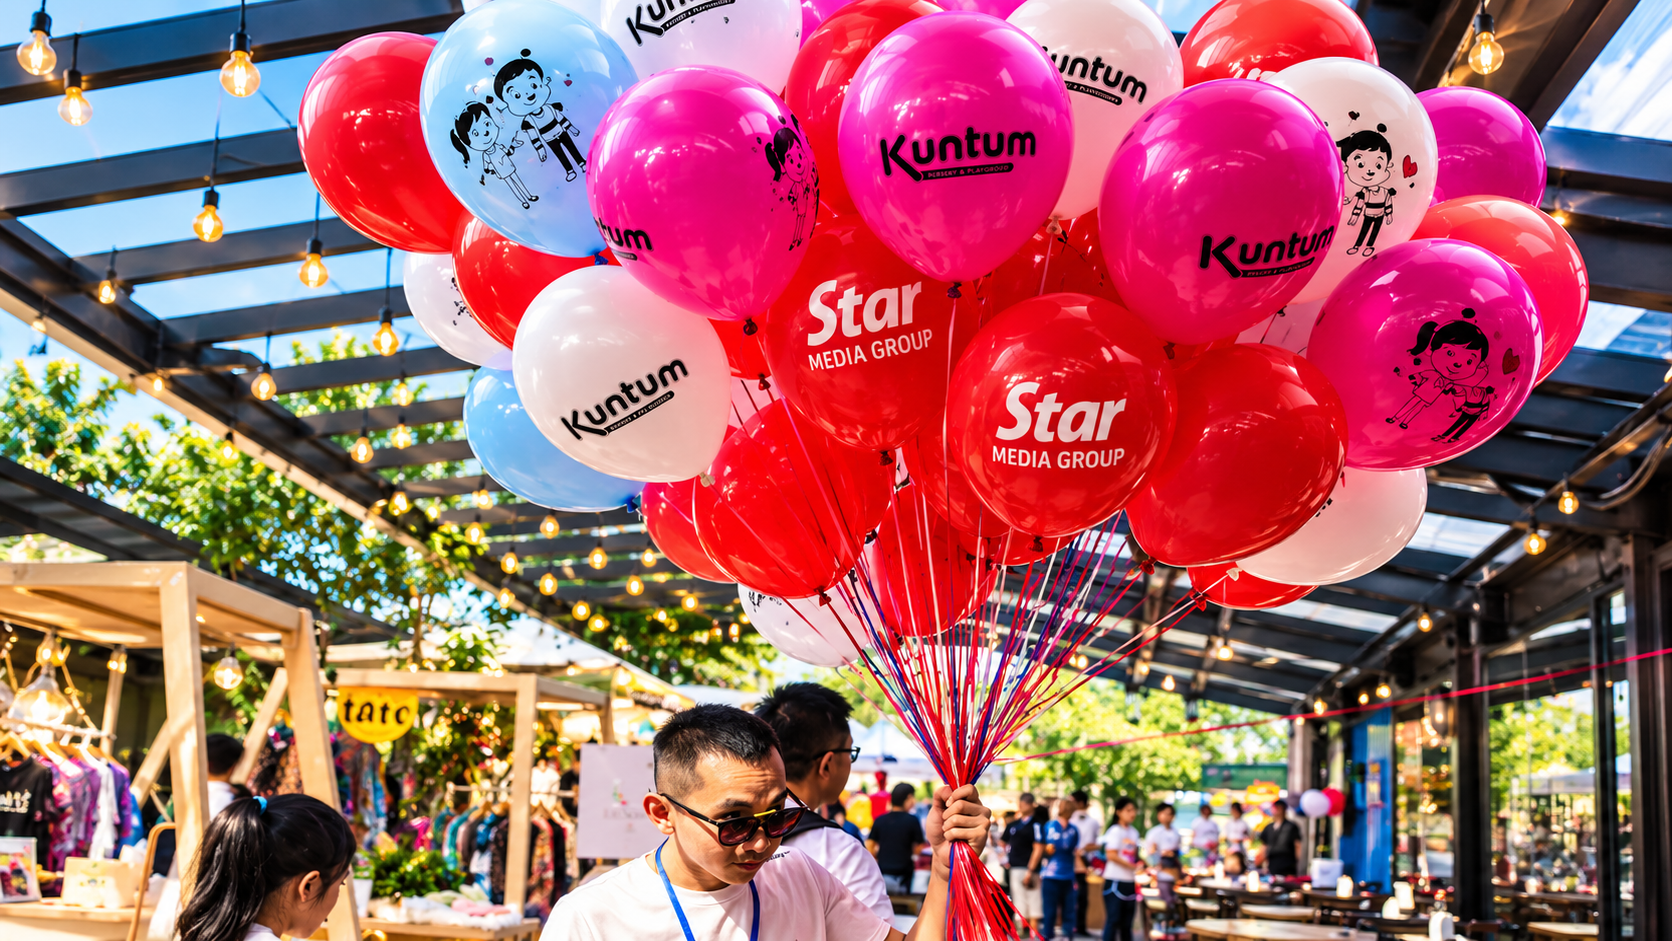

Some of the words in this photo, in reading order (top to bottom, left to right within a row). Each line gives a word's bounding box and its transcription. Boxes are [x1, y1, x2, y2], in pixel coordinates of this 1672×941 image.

[1041, 46, 1147, 103] untum
[880, 126, 1036, 182] Kuntum
[1199, 225, 1335, 278] Kuntum
[807, 279, 922, 347] Star
[808, 344, 868, 371] MEDIA
[871, 328, 933, 360] GROUP
[560, 359, 688, 440] Kuntum
[995, 381, 1127, 443] Star
[992, 445, 1052, 469] MEDIA
[1057, 447, 1125, 469] GROUP
